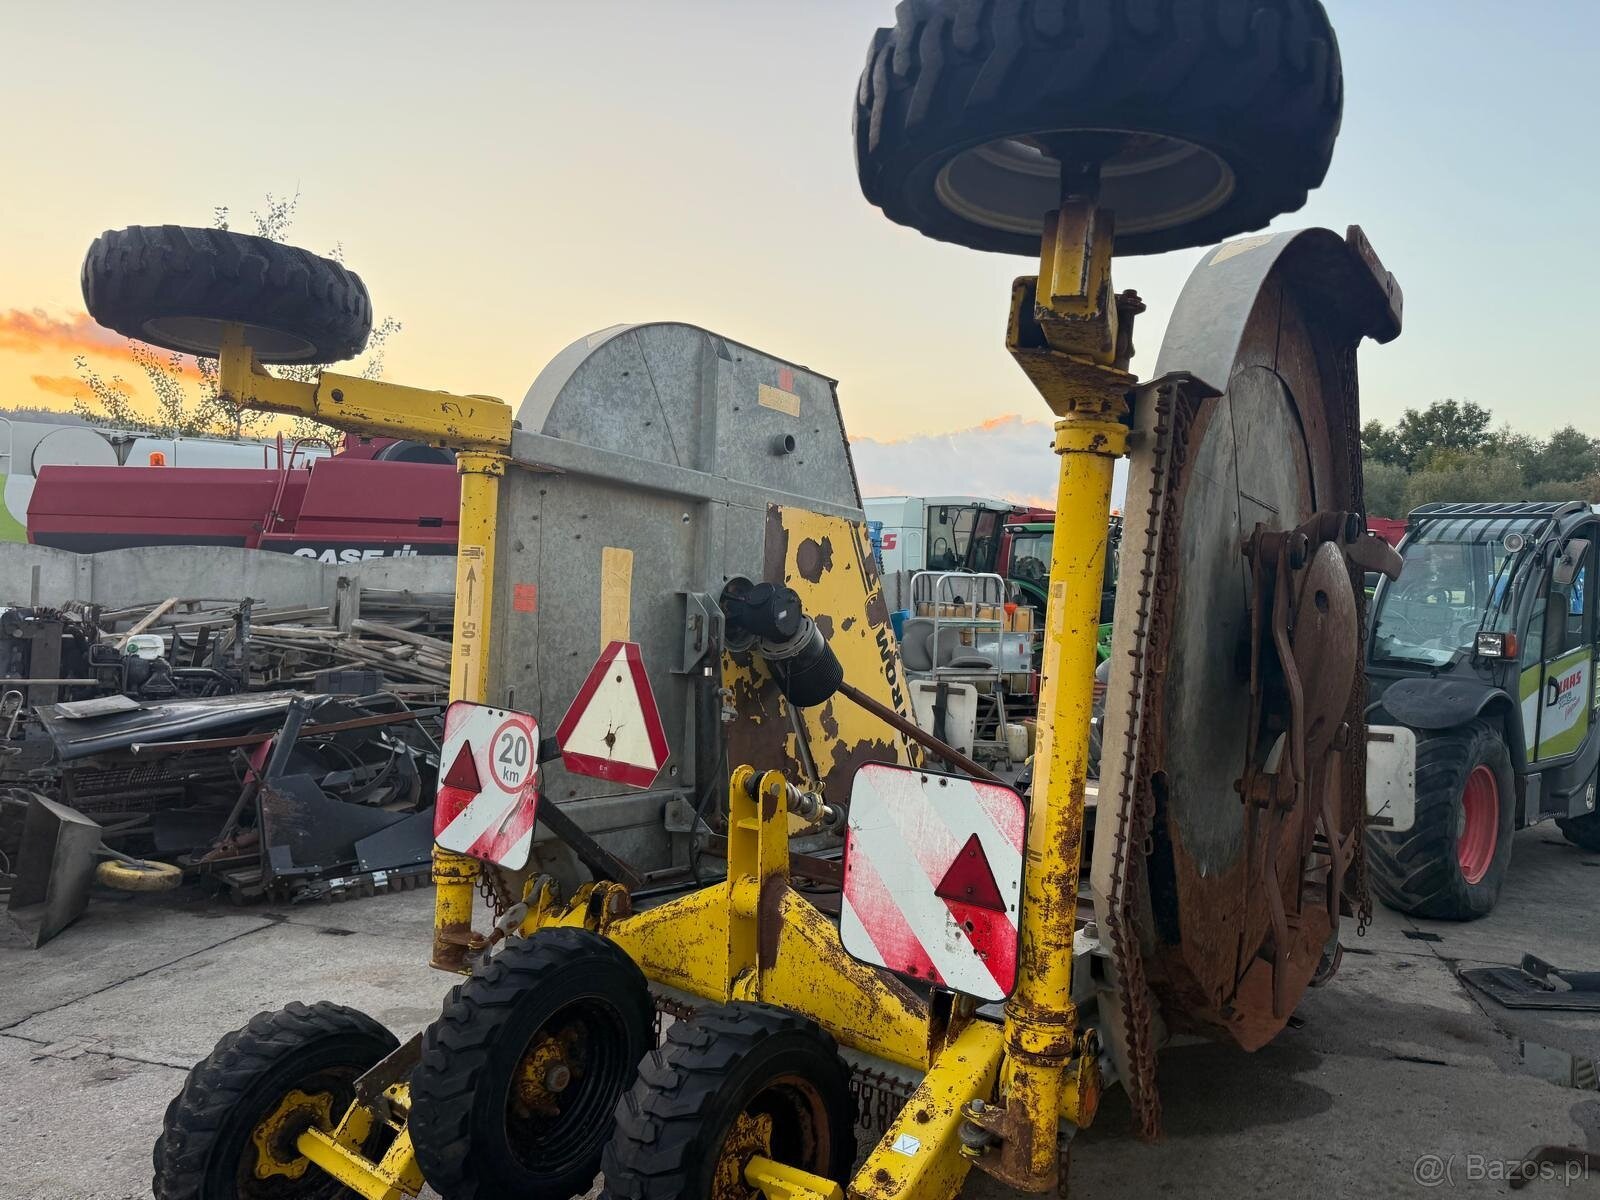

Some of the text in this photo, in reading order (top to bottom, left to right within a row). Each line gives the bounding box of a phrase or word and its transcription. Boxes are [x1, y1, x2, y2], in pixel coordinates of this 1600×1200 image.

[460, 621, 476, 657] 50 m
[499, 733, 526, 767] 20
[503, 766, 519, 783] km
